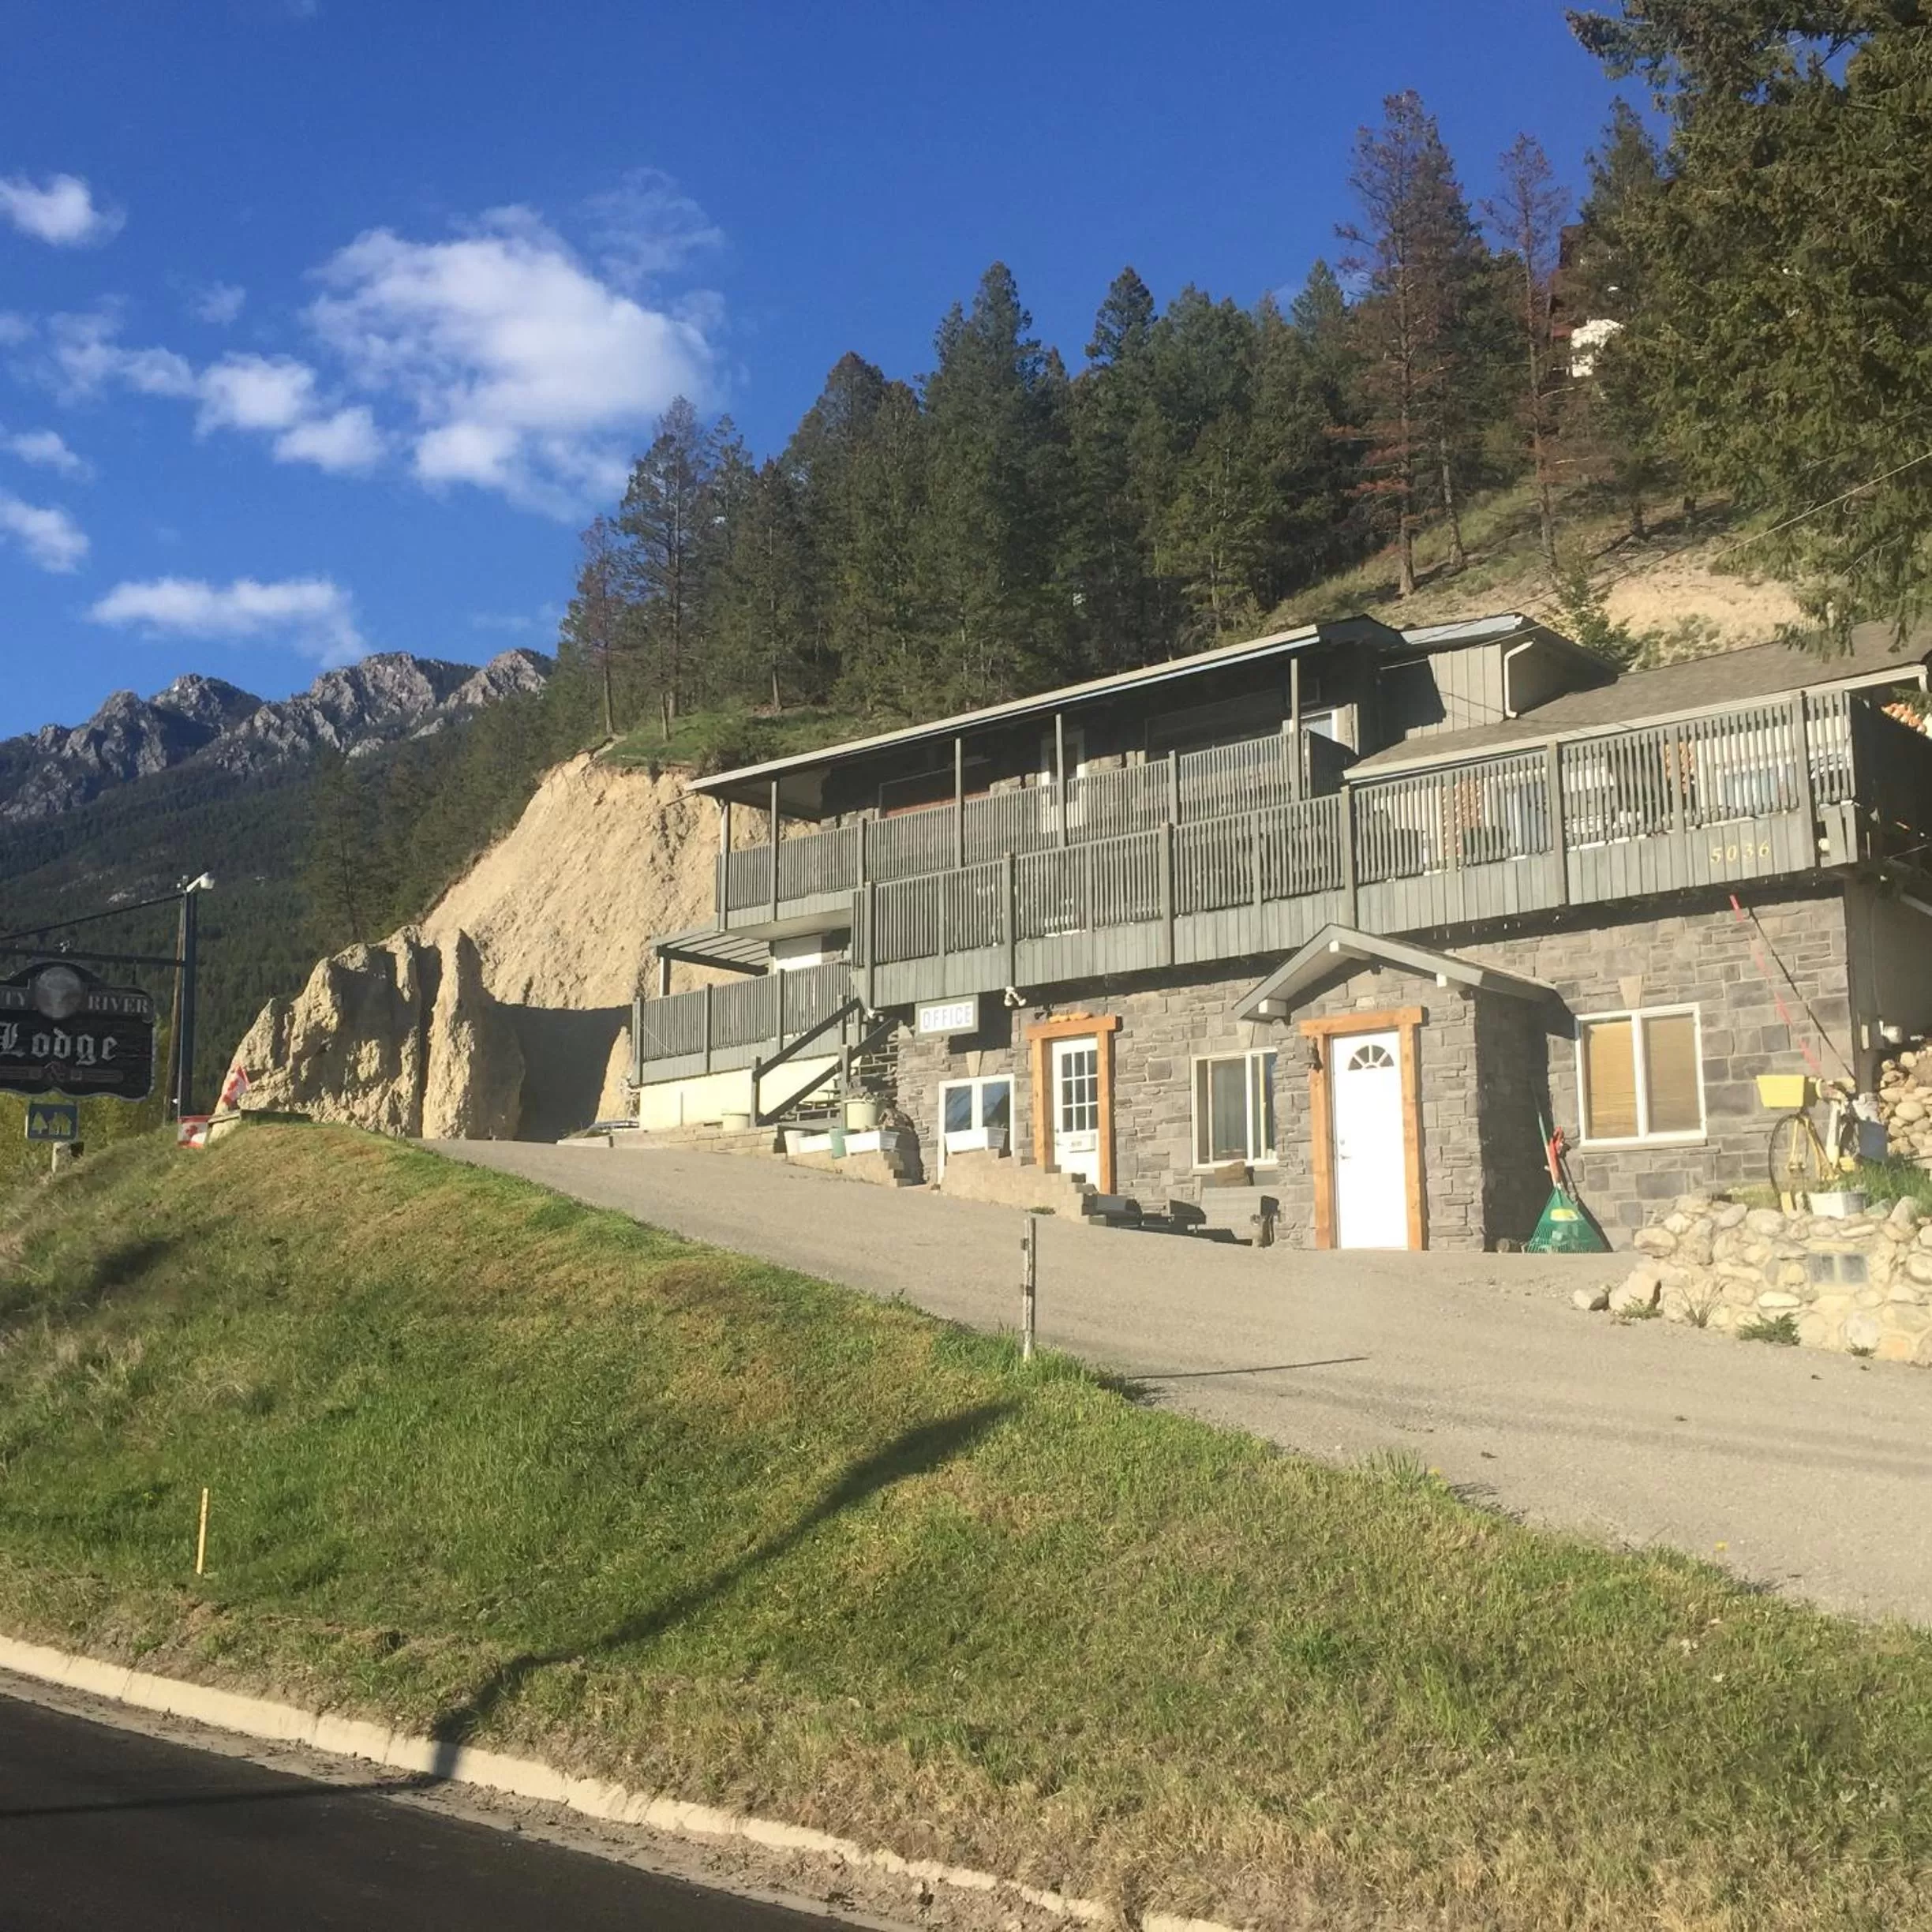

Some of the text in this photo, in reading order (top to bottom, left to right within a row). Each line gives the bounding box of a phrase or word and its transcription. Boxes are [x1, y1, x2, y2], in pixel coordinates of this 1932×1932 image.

[1710, 840, 1769, 863] 5036
[88, 994, 148, 1013] RIVER
[923, 1005, 972, 1029] OFFICE
[0, 1023, 118, 1065] Lodge
